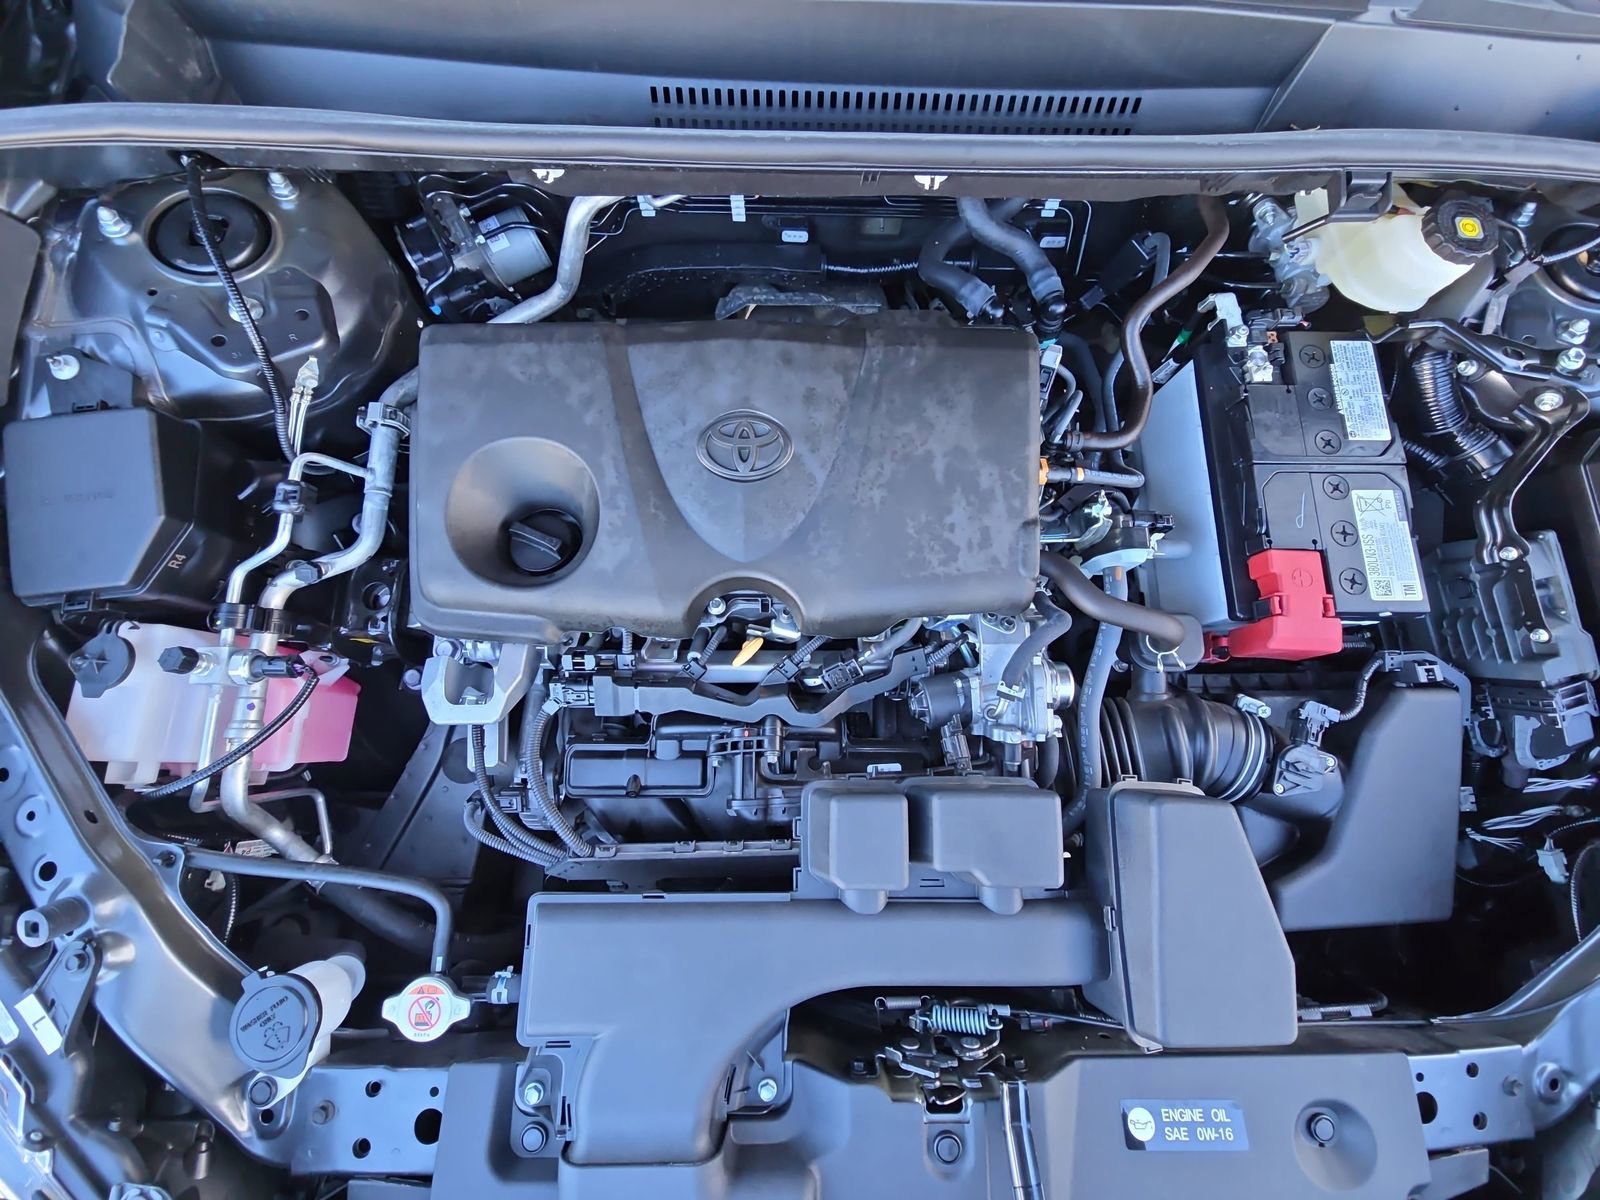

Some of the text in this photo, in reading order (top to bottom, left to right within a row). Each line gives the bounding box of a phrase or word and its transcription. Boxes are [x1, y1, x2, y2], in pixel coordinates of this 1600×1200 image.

[167, 553, 187, 569] R4
[1402, 584, 1417, 596] TM
[32, 1015, 46, 1031] L
[1161, 1108, 1231, 1122] ENGINE OIL
[1164, 1127, 1234, 1141] SAE 0W-16
